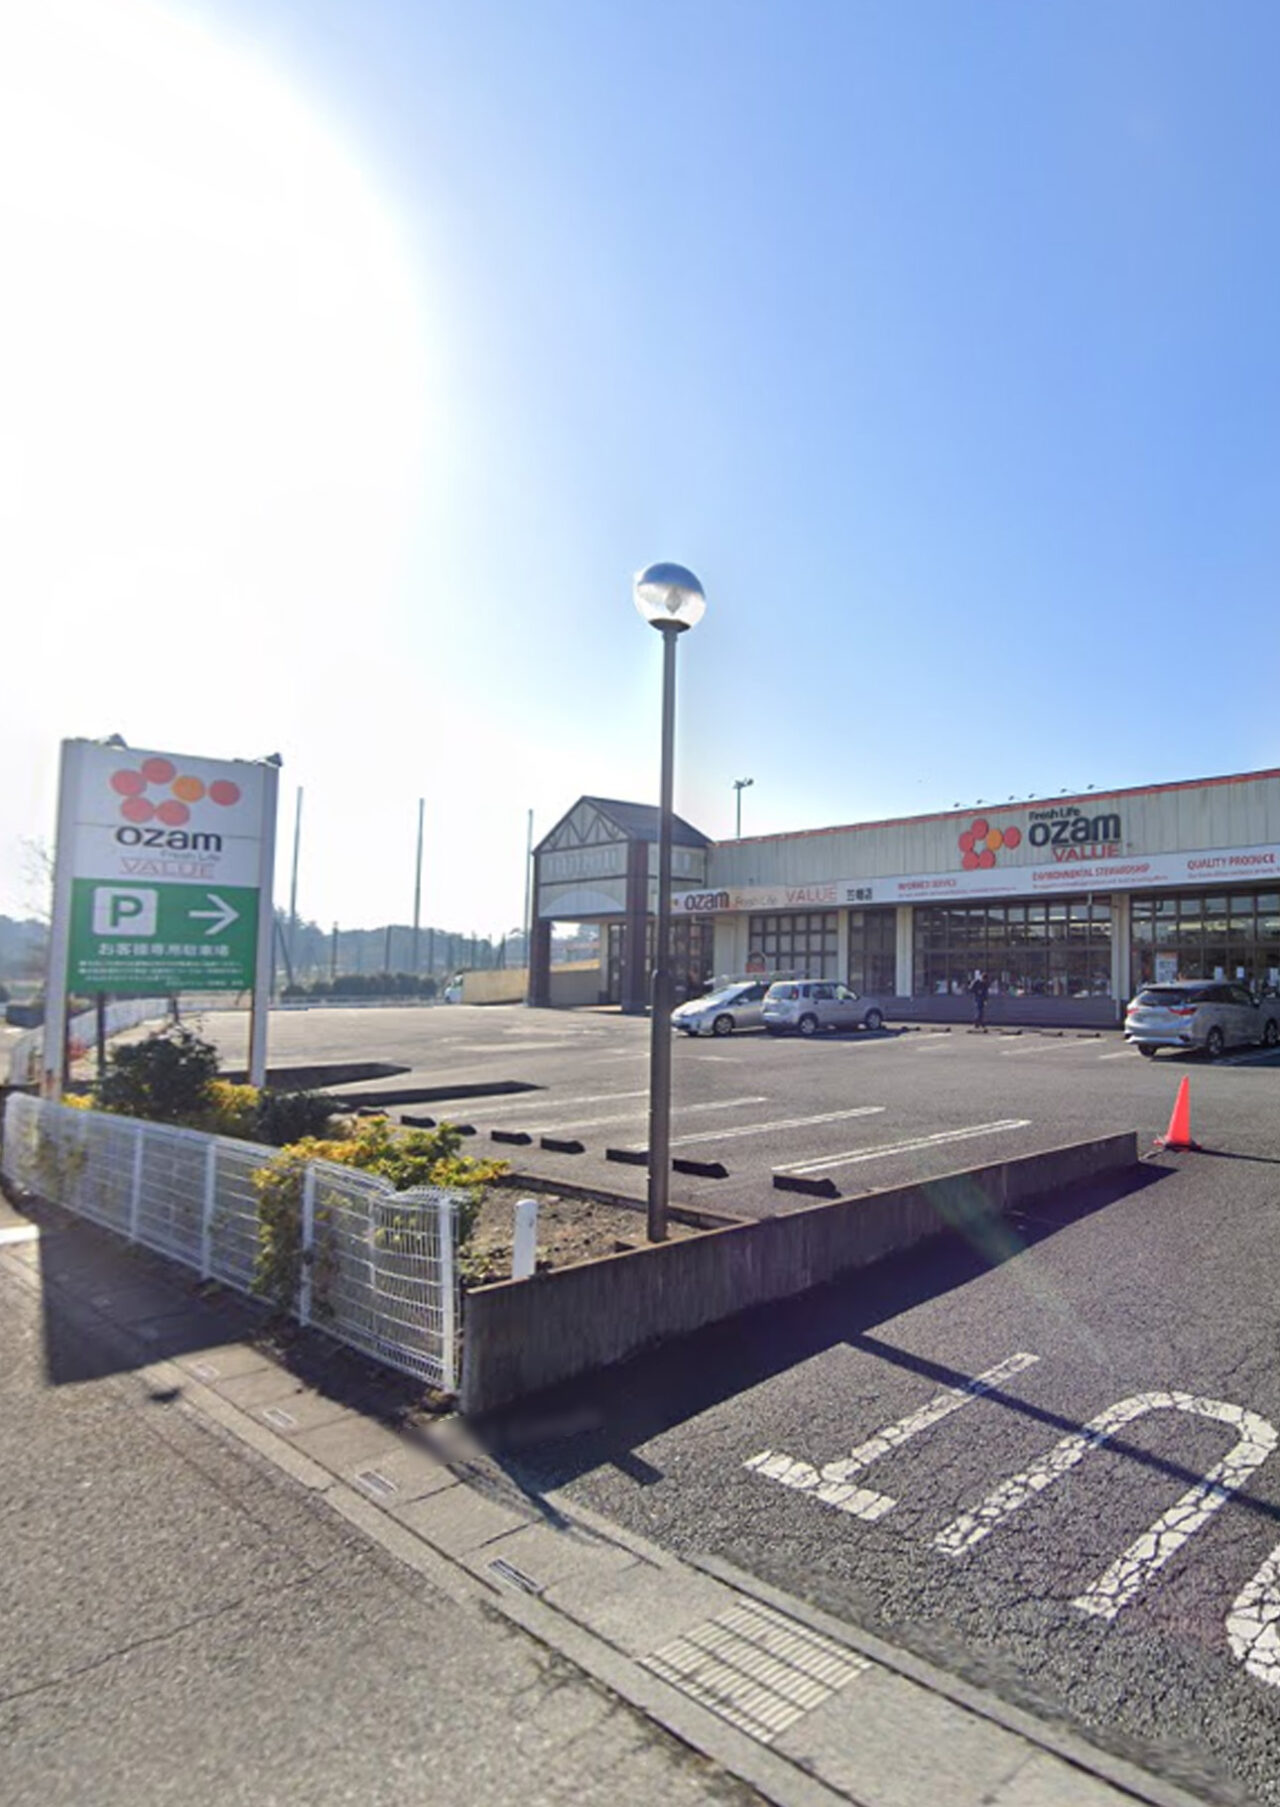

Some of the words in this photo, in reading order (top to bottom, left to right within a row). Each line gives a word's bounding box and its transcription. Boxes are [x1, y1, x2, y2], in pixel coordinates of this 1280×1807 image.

[115, 826, 222, 852] ozam
[1028, 813, 1121, 847] ozam
[1052, 844, 1119, 863] VALUE
[1187, 857, 1227, 871] QUALITY
[1229, 853, 1276, 867] PRODUCE
[118, 857, 216, 879] VALUE
[684, 891, 730, 911] ozam
[785, 885, 837, 903] VALUE
[109, 895, 144, 928] P
